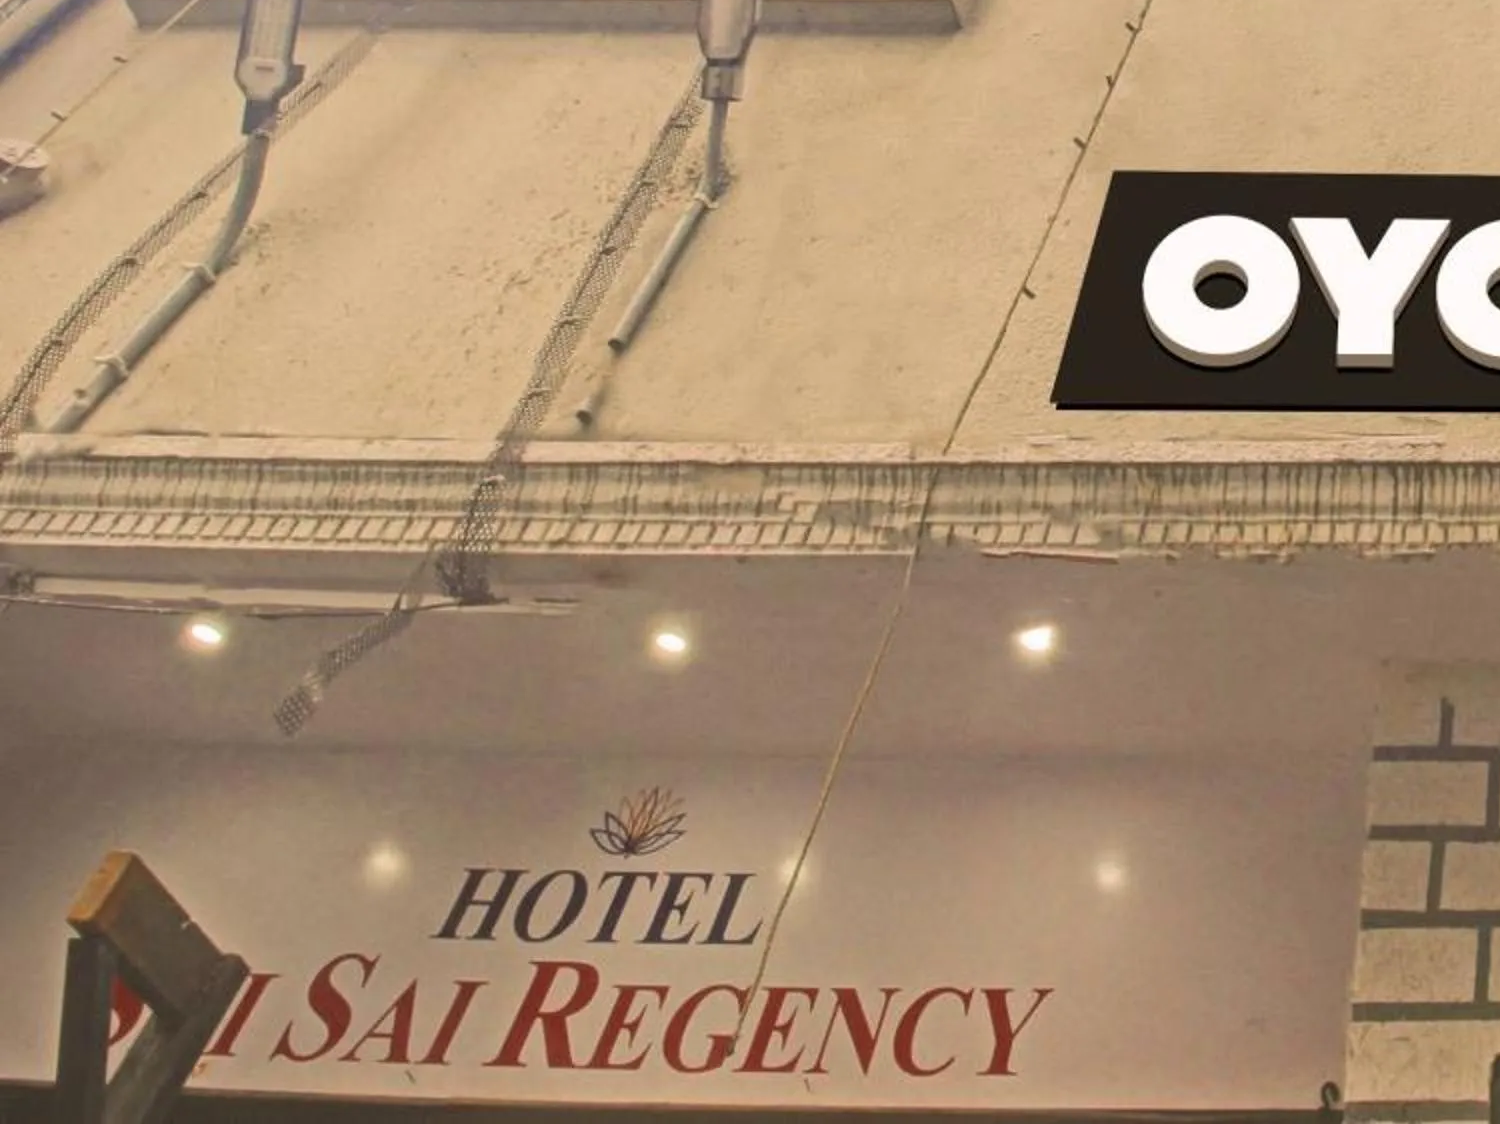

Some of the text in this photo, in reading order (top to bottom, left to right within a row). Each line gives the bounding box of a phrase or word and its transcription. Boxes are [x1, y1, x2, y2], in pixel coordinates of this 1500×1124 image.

[429, 868, 764, 946] HOTEL
[269, 953, 489, 1065] SAI
[482, 960, 1054, 1077] REGENCY
